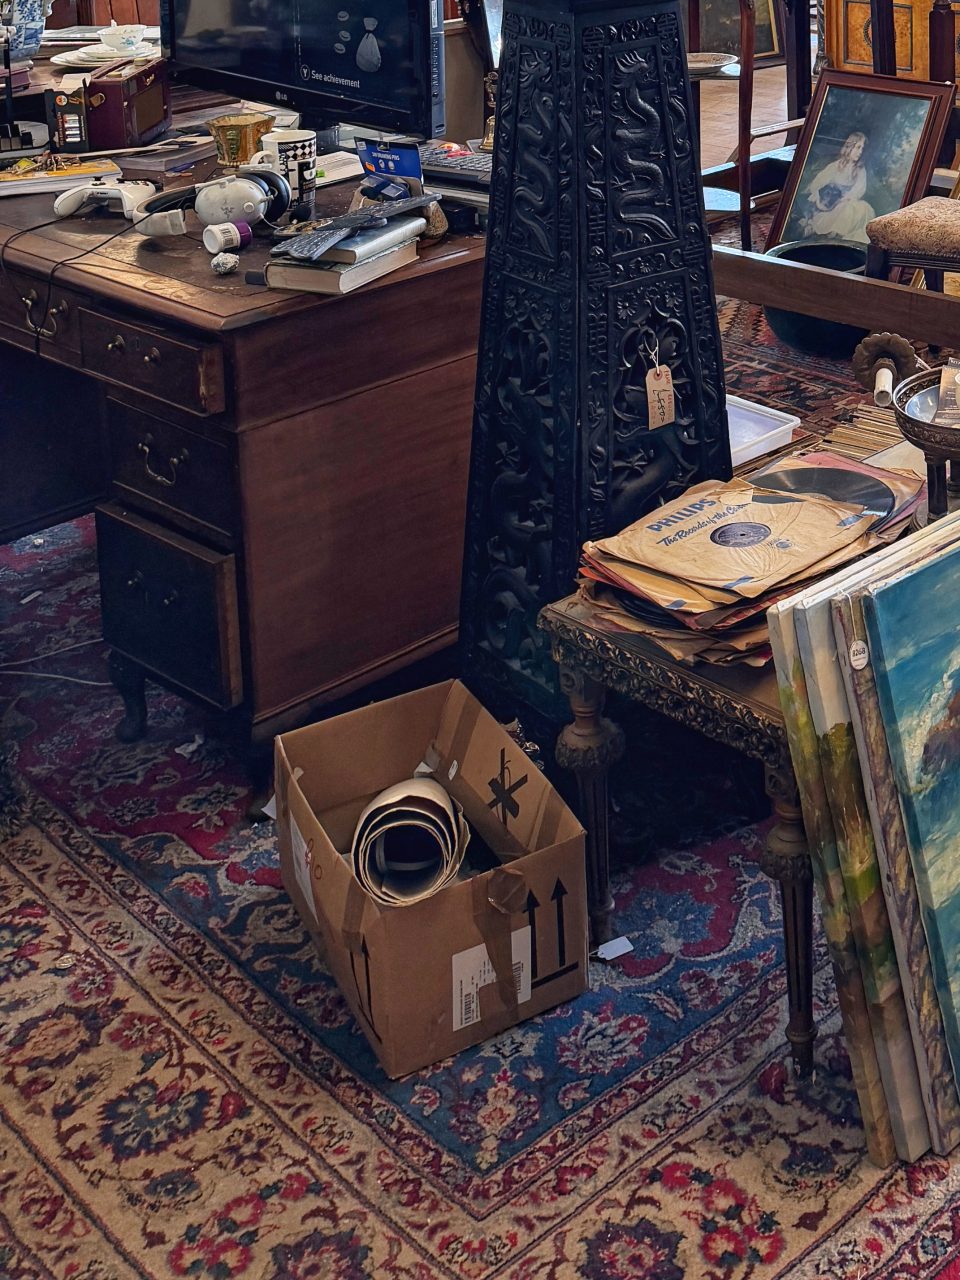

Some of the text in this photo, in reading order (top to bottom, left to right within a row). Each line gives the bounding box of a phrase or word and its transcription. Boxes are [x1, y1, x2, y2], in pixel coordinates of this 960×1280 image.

[311, 70, 322, 80] See
[323, 74, 360, 88] achievement
[646, 498, 717, 532] PHILIPS
[656, 535, 678, 546] The
[675, 521, 707, 539] Records
[712, 511, 728, 521] the
